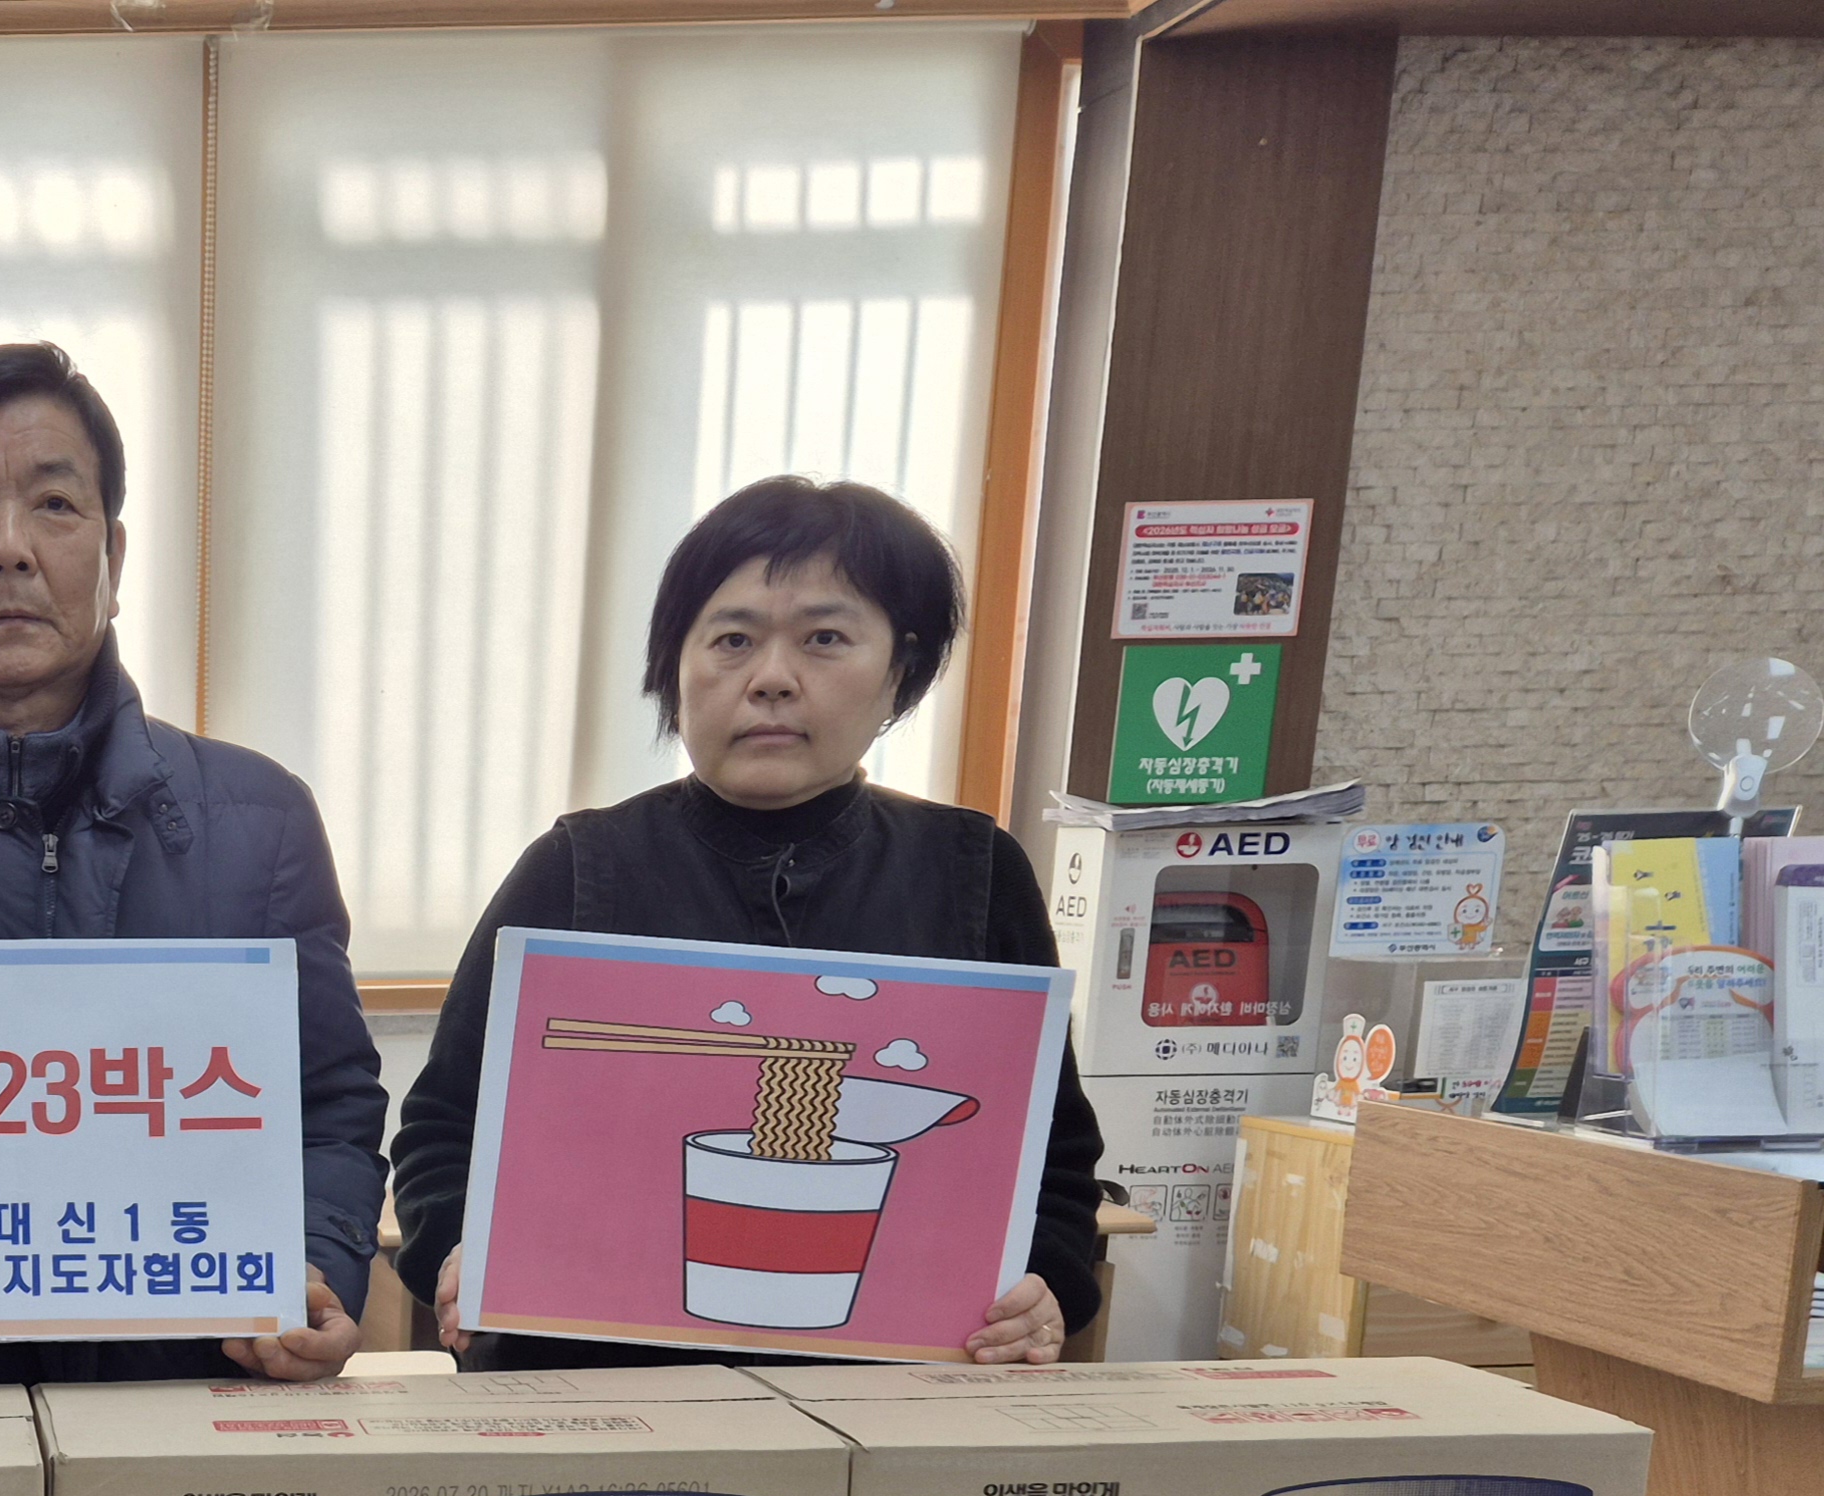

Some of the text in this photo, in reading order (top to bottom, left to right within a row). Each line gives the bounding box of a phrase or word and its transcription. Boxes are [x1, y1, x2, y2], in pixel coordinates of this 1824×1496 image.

[1139, 757, 1239, 775] 자동심장충격기
[1208, 832, 1291, 856] AED
[1055, 895, 1087, 918] AED
[1169, 949, 1236, 968] AED
[1181, 1041, 1268, 1056] (주) 메디아나
[1155, 1089, 1248, 1105] 자동심장충격기
